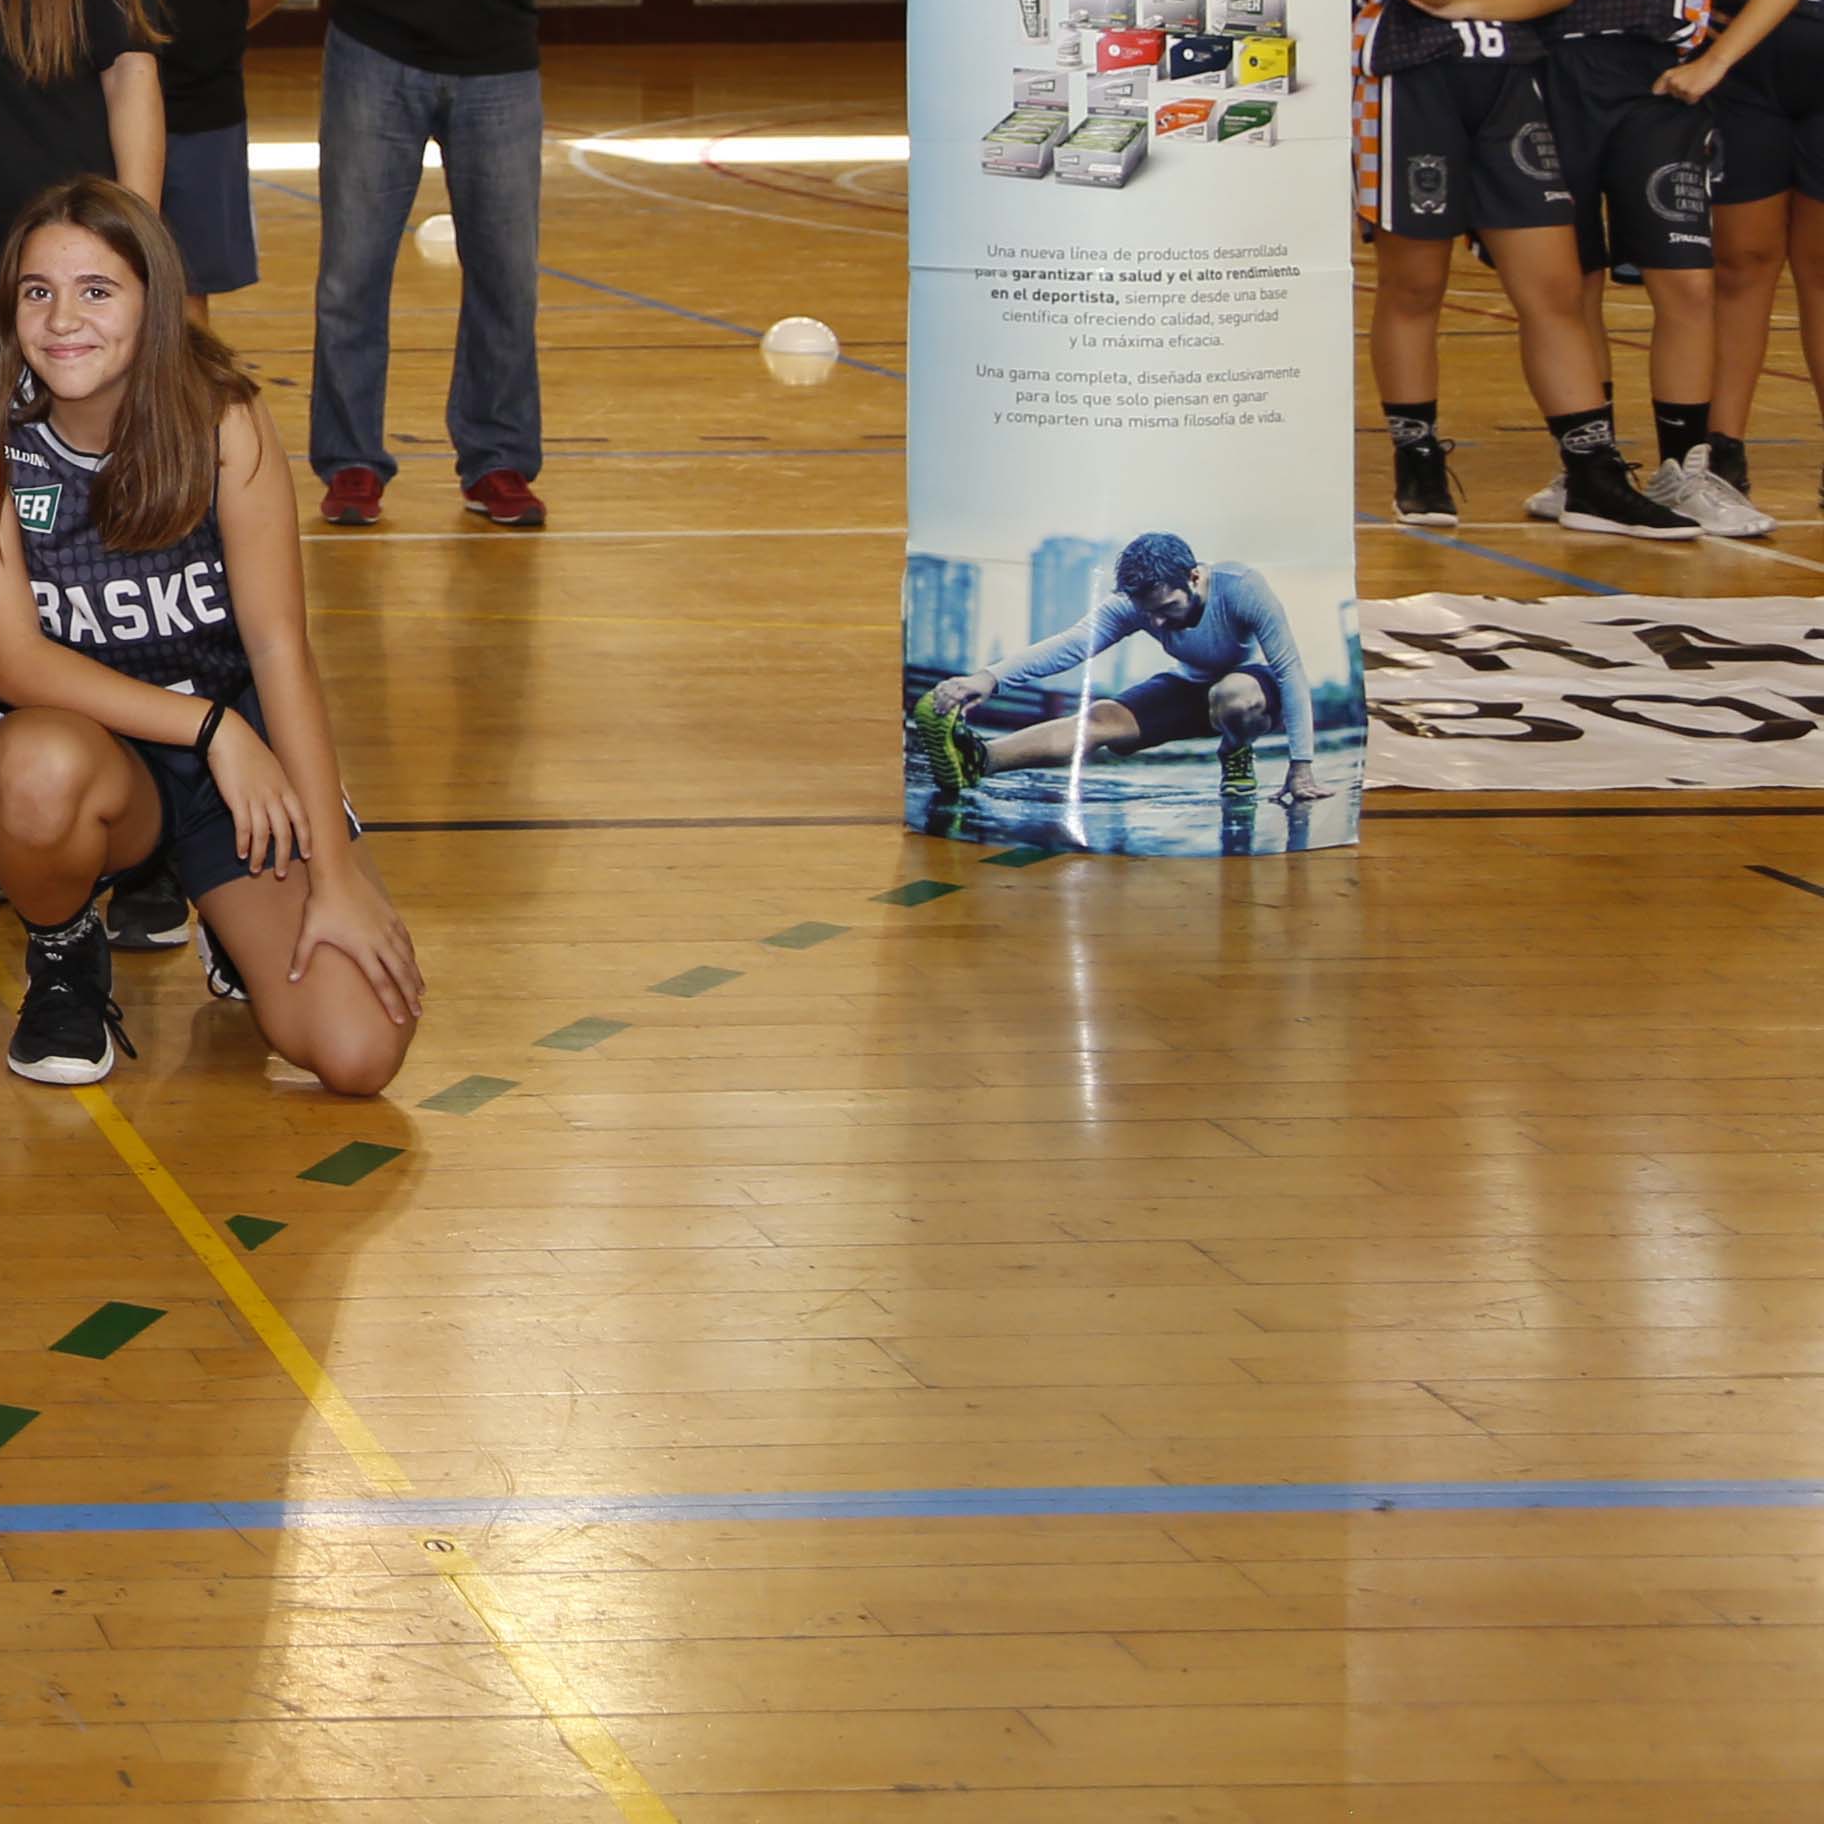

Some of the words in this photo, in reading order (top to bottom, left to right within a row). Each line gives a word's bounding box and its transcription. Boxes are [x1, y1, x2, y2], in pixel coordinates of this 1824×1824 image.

[987, 244, 1015, 258] Una
[1021, 248, 1064, 260] nueva
[1070, 245, 1108, 261] línea
[1113, 247, 1131, 261] de
[1137, 247, 1209, 264] productos
[1214, 243, 1288, 259] desarrollada
[975, 268, 1007, 280] para
[1012, 268, 1093, 286] garantizar
[1119, 269, 1162, 282] salud
[1167, 272, 1175, 285] y
[1179, 269, 1192, 281] el
[1197, 268, 1223, 281] alto
[1226, 265, 1300, 280] rendimiento
[991, 288, 1008, 301] en
[1013, 288, 1027, 301] el
[1032, 290, 1120, 306] deportista,
[1124, 291, 1185, 308] siempre
[1190, 290, 1230, 303] desde
[1234, 291, 1256, 301] una
[1261, 288, 1288, 301] base
[1002, 309, 1068, 324] científica
[1074, 311, 1155, 327] ofreciendo
[1161, 312, 1214, 327] calidad,
[1218, 309, 1278, 327] seguridad
[1070, 336, 1077, 349] y
[1083, 334, 1096, 347] la
[1103, 334, 1163, 348] máxima
[1169, 334, 1224, 348] eficacia.
[976, 364, 1004, 378] Una
[1009, 369, 1050, 383] gama
[1055, 368, 1131, 386] completa,
[1137, 369, 1201, 384] diseñada
[1207, 366, 1301, 383] exclusivamente
[1016, 390, 1050, 405] para
[1055, 390, 1078, 405] los
[1083, 393, 1111, 408] que
[1116, 391, 1148, 407] solo
[1154, 391, 1208, 408] piensan
[1213, 392, 1228, 404] en
[1233, 390, 1268, 407] ganar
[994, 411, 1001, 424] y
[1006, 412, 1088, 430] comparten
[1094, 415, 1122, 427] una
[1128, 414, 1178, 427] misma
[1184, 410, 1235, 428] filosofía
[1239, 412, 1254, 424] de
